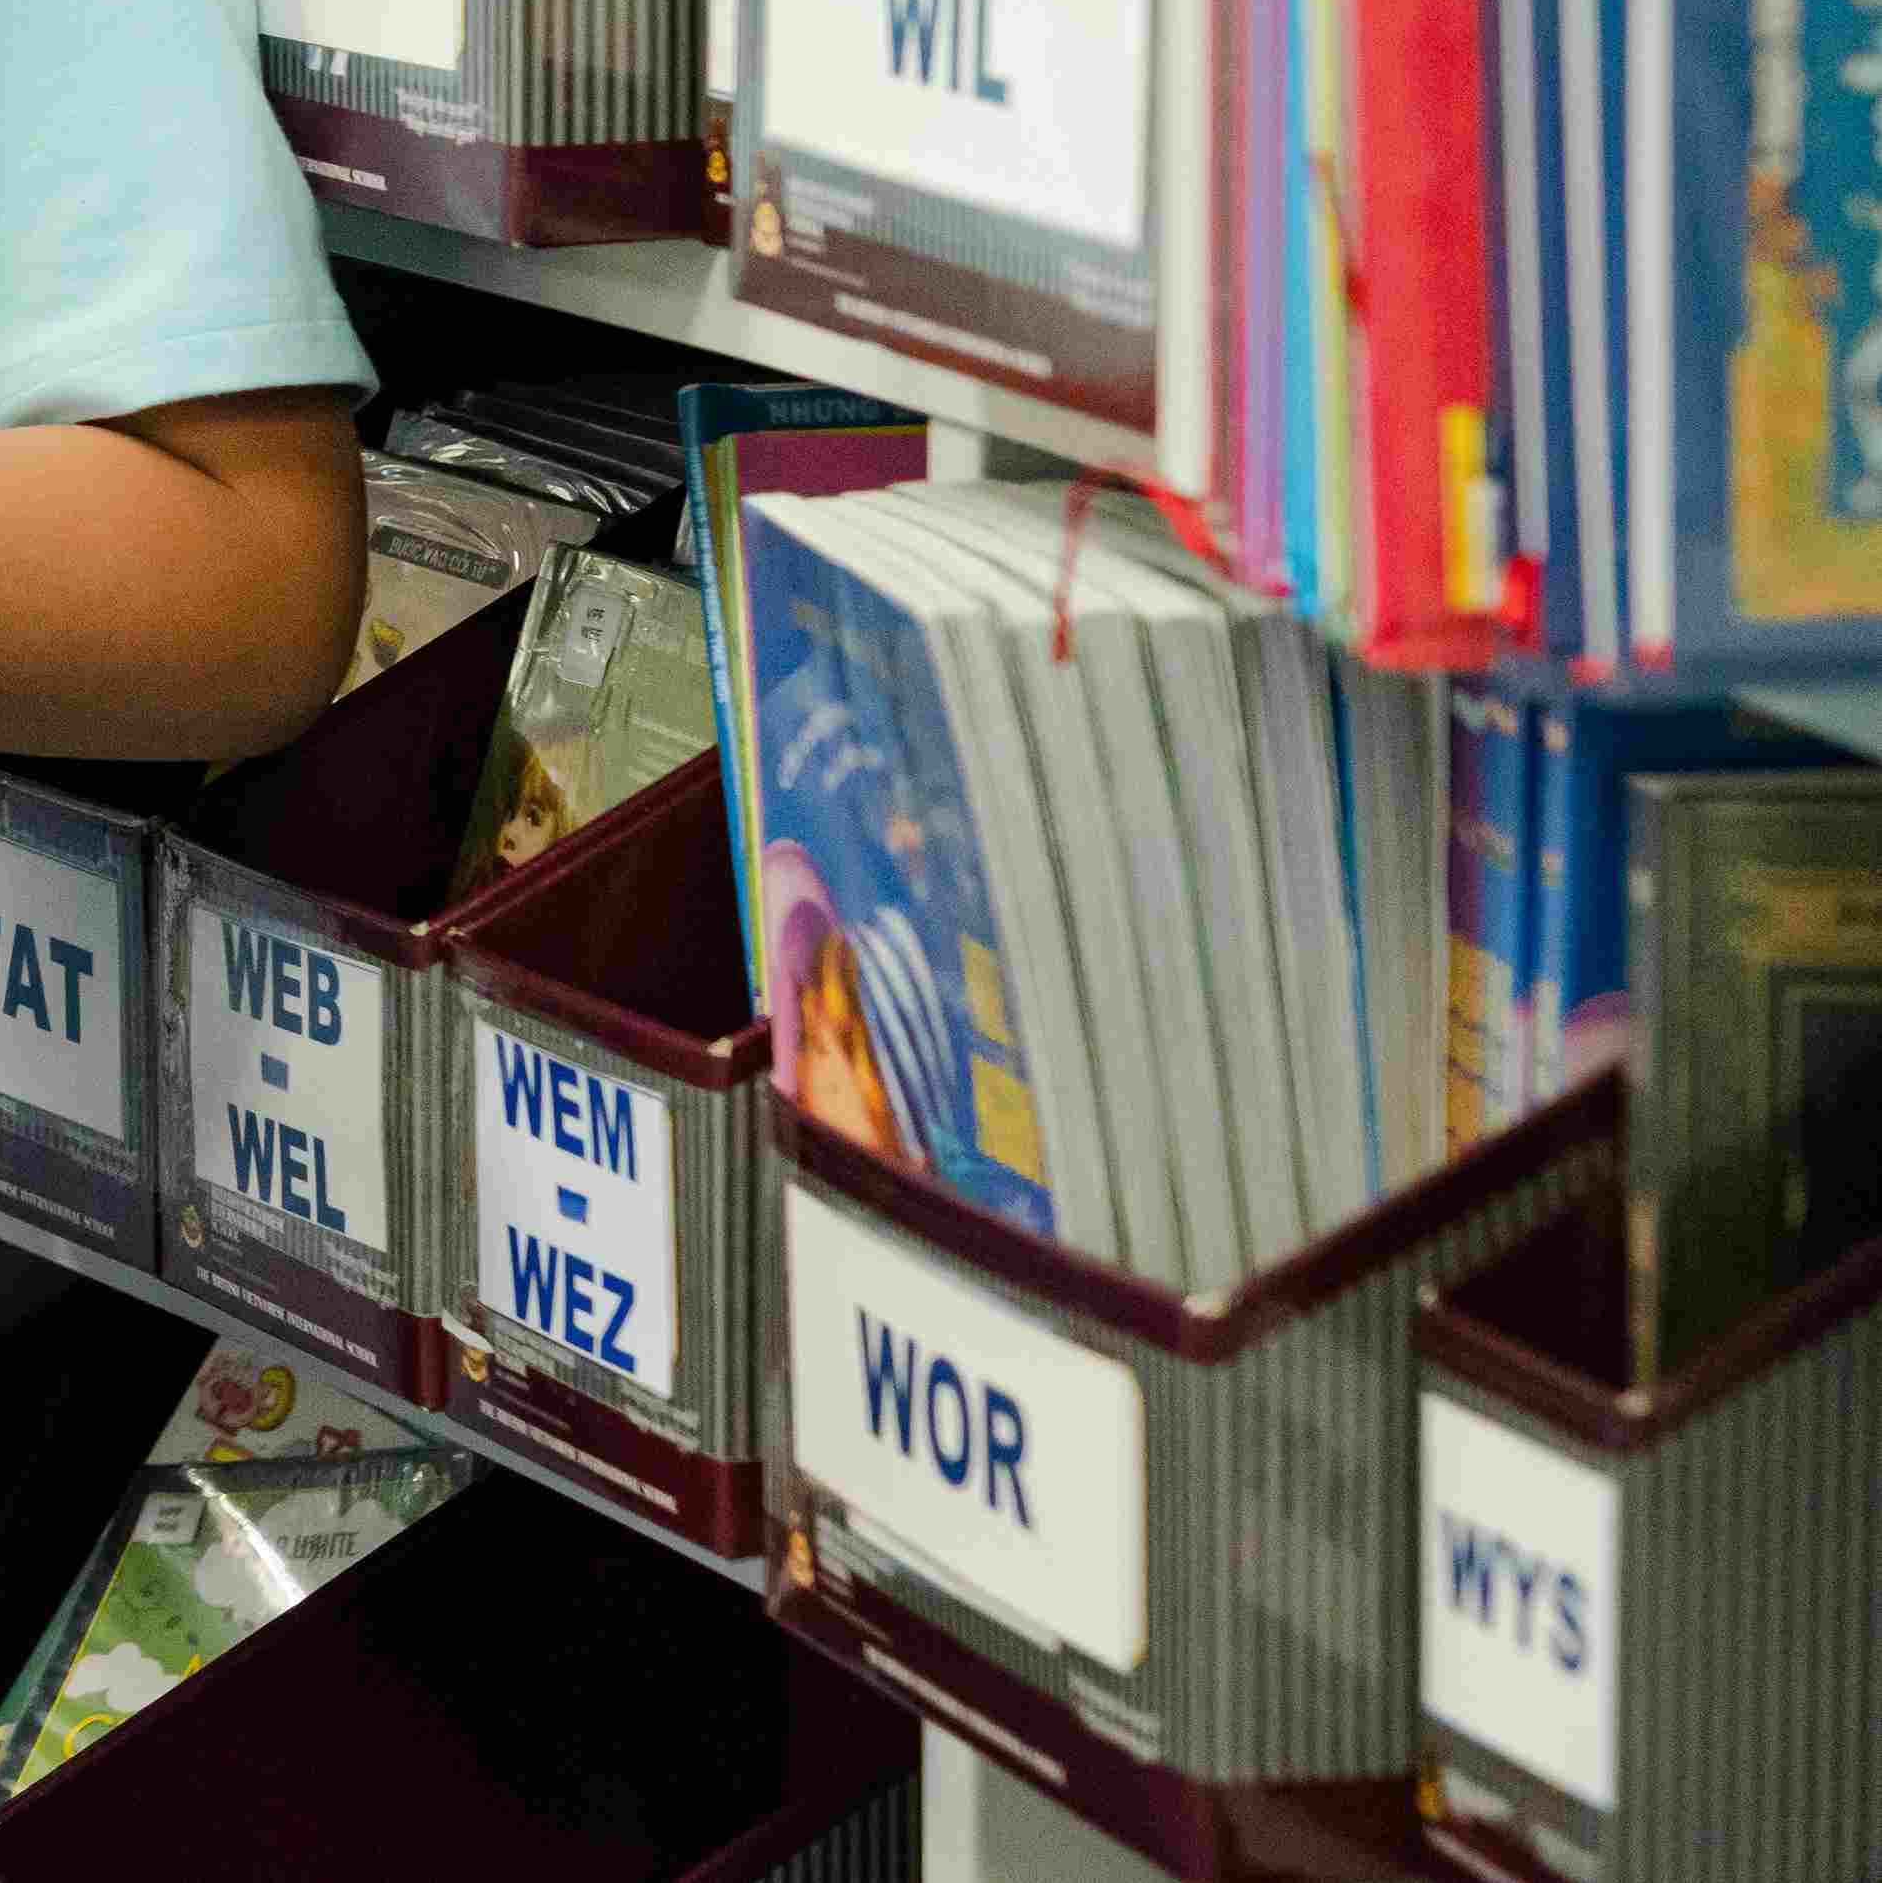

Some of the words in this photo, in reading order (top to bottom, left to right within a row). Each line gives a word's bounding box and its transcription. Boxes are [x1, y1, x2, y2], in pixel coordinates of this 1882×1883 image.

[222, 921, 342, 1045] WEB
[259, 1052, 288, 1090] -
[496, 1031, 637, 1181] WEM
[228, 1102, 345, 1232] WEL
[557, 1187, 588, 1222] -
[507, 1222, 635, 1374] WEZ
[860, 1308, 1030, 1530] WOR
[1444, 1517, 1585, 1673] WYS
